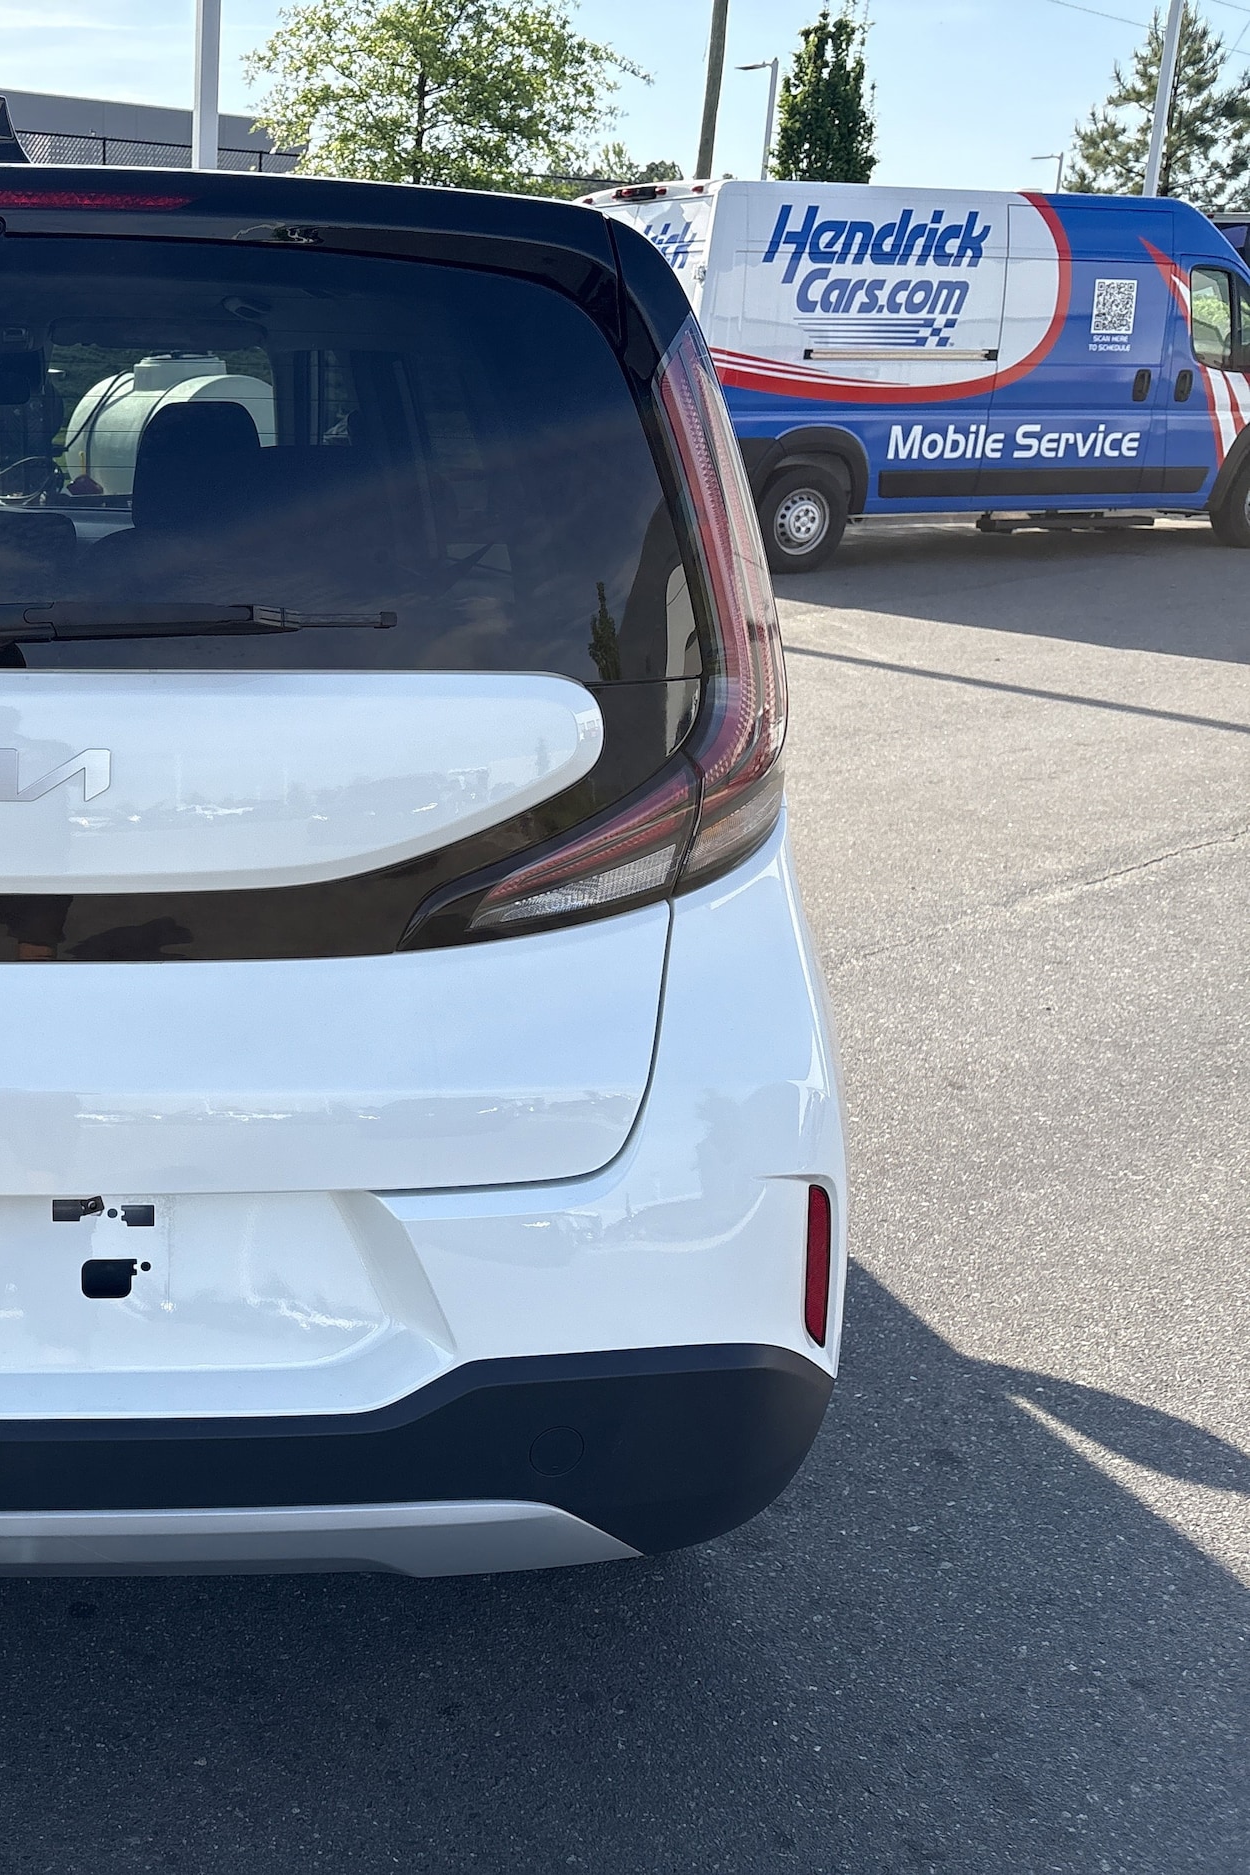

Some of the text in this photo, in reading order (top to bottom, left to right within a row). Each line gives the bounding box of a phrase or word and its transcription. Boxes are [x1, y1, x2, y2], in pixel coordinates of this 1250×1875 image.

[762, 204, 992, 284] Hendrick
[796, 267, 970, 315] Cars.com
[1088, 343, 1131, 352] TO SCHEDULE
[1111, 335, 1129, 343] HERE
[887, 424, 1141, 460] Mobile Service
